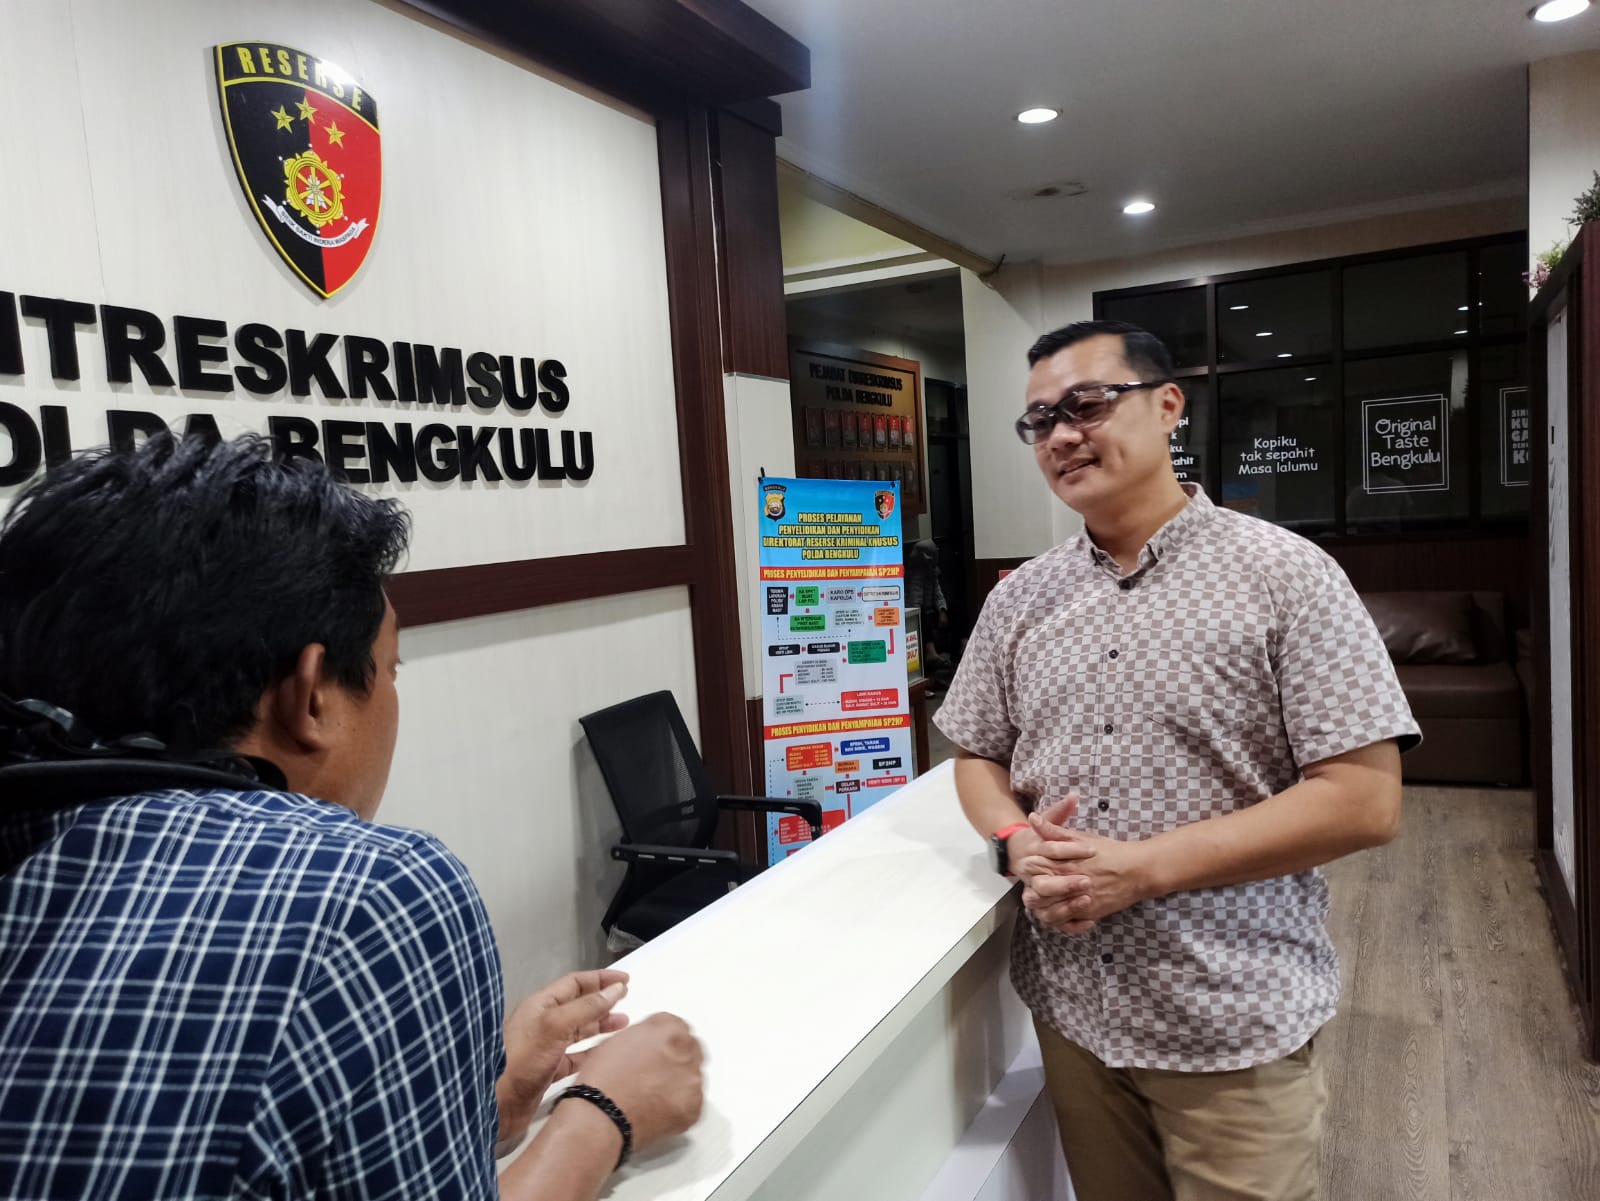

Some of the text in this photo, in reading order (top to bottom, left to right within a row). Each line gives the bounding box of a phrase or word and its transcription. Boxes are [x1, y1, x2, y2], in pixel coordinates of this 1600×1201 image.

[236, 47, 362, 112] RESERSE
[1375, 415, 1436, 437] Original
[268, 415, 595, 482] BENGKULU
[1254, 435, 1297, 451] Kopiku
[1381, 434, 1429, 449] Taste
[1240, 447, 1316, 462] tak sepahit
[1370, 448, 1441, 470] Bengkulu
[1238, 460, 1318, 475] Masa lalumu
[798, 513, 862, 523] PROSES PELAYANAN
[779, 525, 880, 535] PENYELIDIKAN DAN PENYIDIKAN
[763, 536, 898, 547] DIREKTORAT RESERSE KRIMINAL KHUSUS
[802, 549, 859, 559] POLDA BENGKULU
[763, 569, 785, 578] PROSES
[771, 716, 903, 736] PROSES PENYIDIKAN DAN PENYAMPAIAN SP2HP
